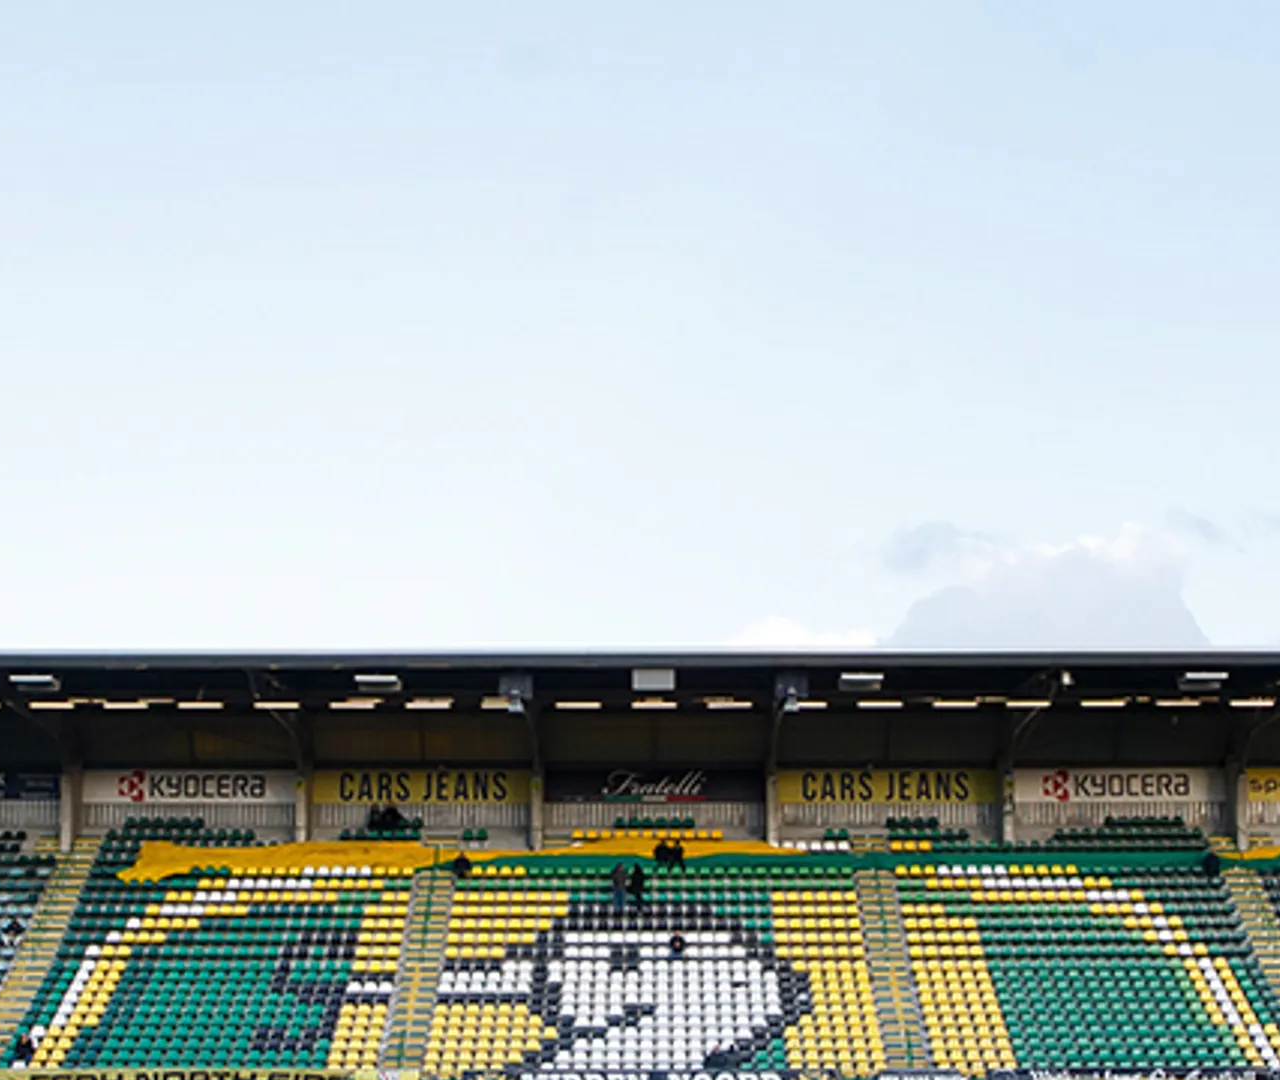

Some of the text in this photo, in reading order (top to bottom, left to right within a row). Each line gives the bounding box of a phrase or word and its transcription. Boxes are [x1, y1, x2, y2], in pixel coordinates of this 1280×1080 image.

[339, 772, 507, 801] CARS JEANS
[802, 771, 969, 801] CARS JEANS
